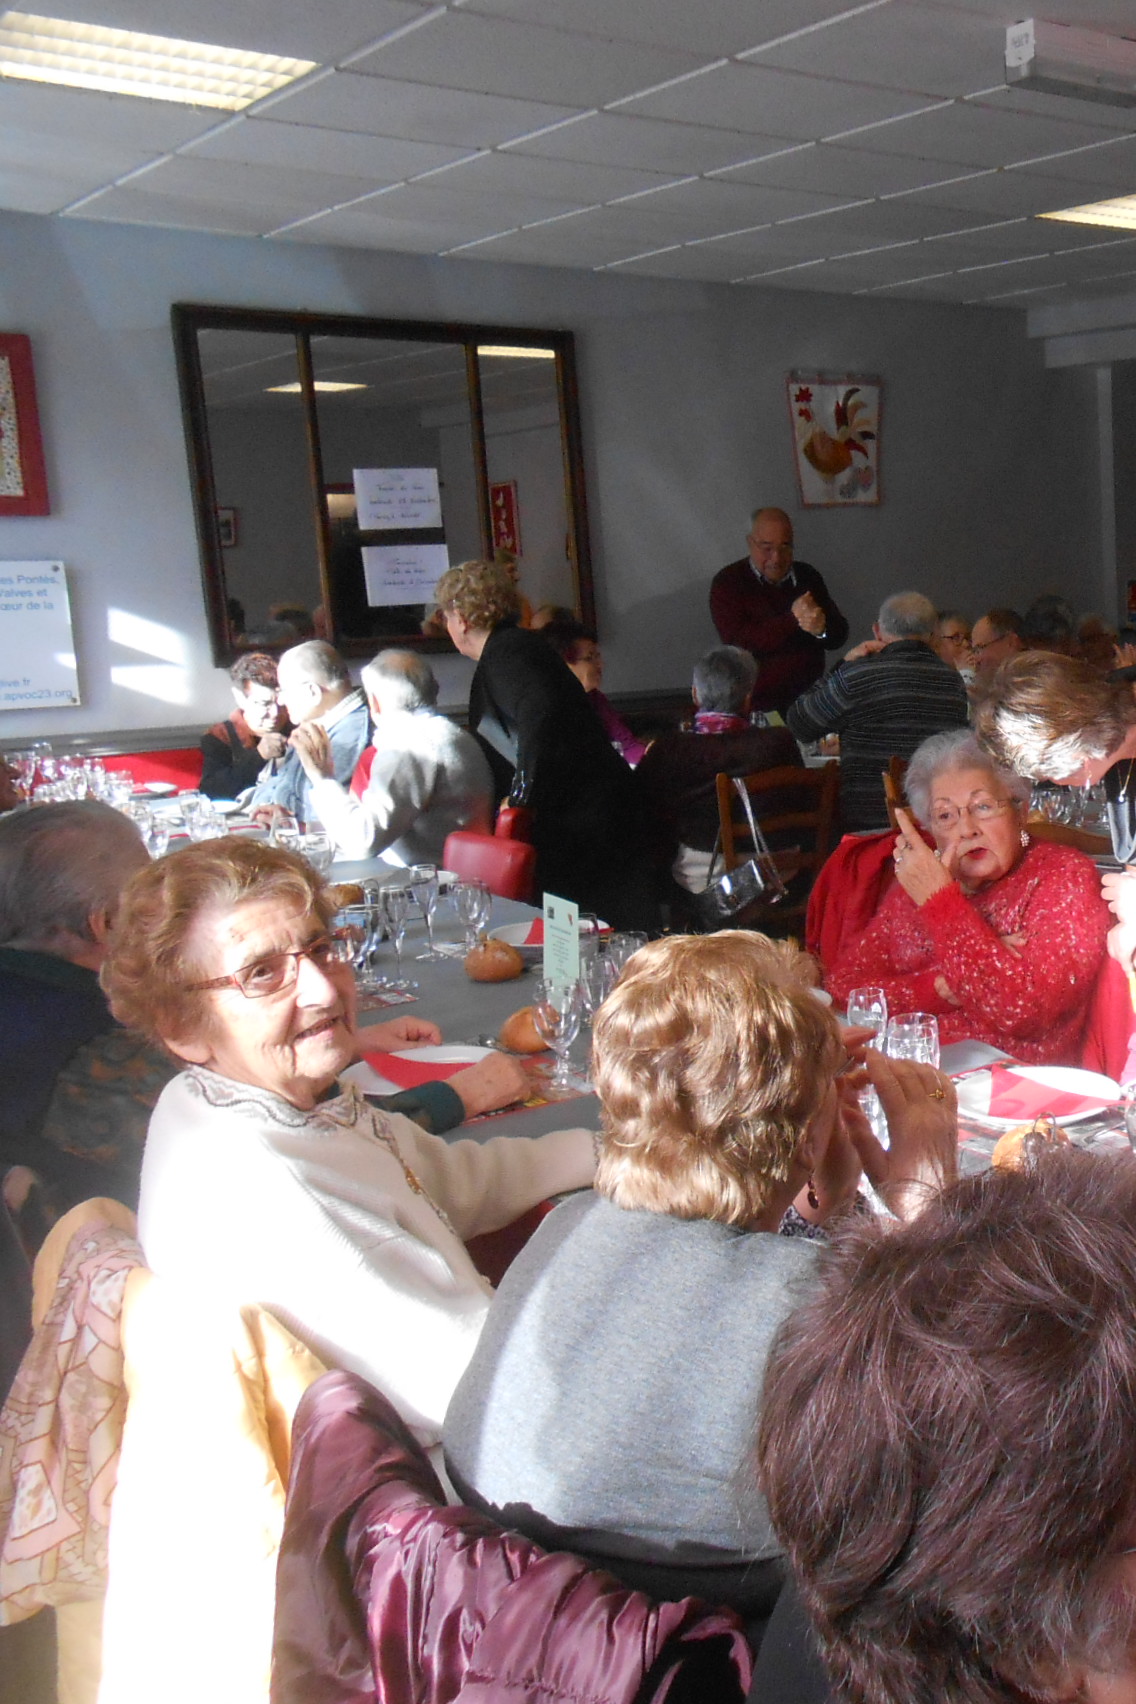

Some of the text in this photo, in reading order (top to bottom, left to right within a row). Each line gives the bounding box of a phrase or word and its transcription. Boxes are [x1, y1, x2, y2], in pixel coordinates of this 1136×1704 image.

[0, 575, 14, 585] es
[36, 589, 48, 598] et
[0, 602, 54, 611] œur de la
